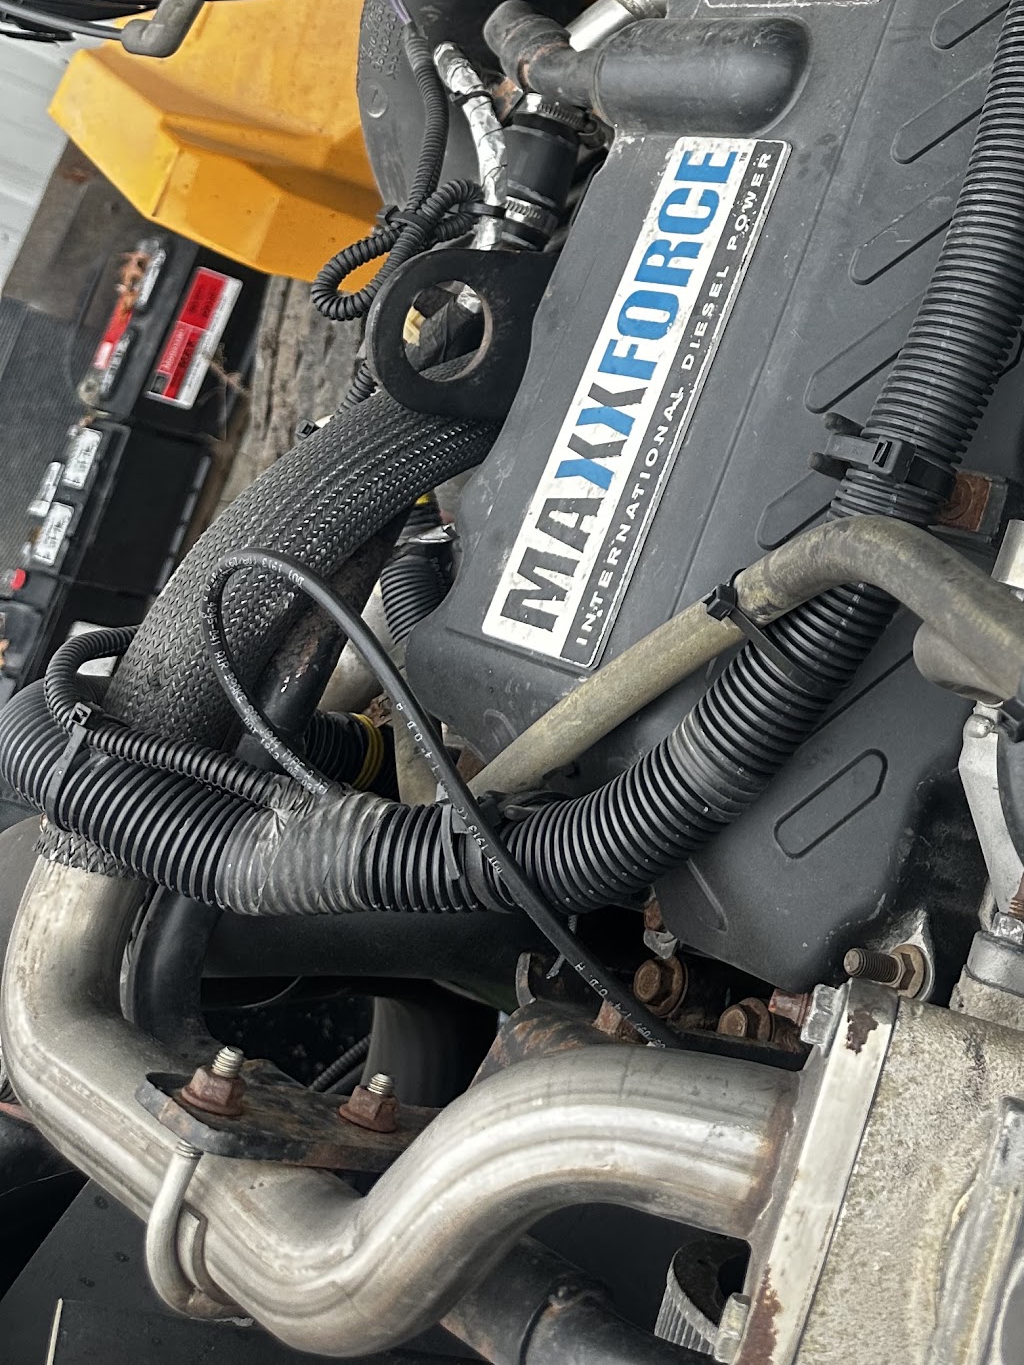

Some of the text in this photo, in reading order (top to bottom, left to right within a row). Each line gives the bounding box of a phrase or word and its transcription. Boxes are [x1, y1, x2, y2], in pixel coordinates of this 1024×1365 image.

[498, 147, 739, 634] MAXXFORCE
[574, 151, 775, 648] INTERNATIONAL DIESEL POWER
[214, 651, 229, 671] AIR
[224, 671, 249, 704] BRAKE
[284, 749, 306, 771] TYPE
